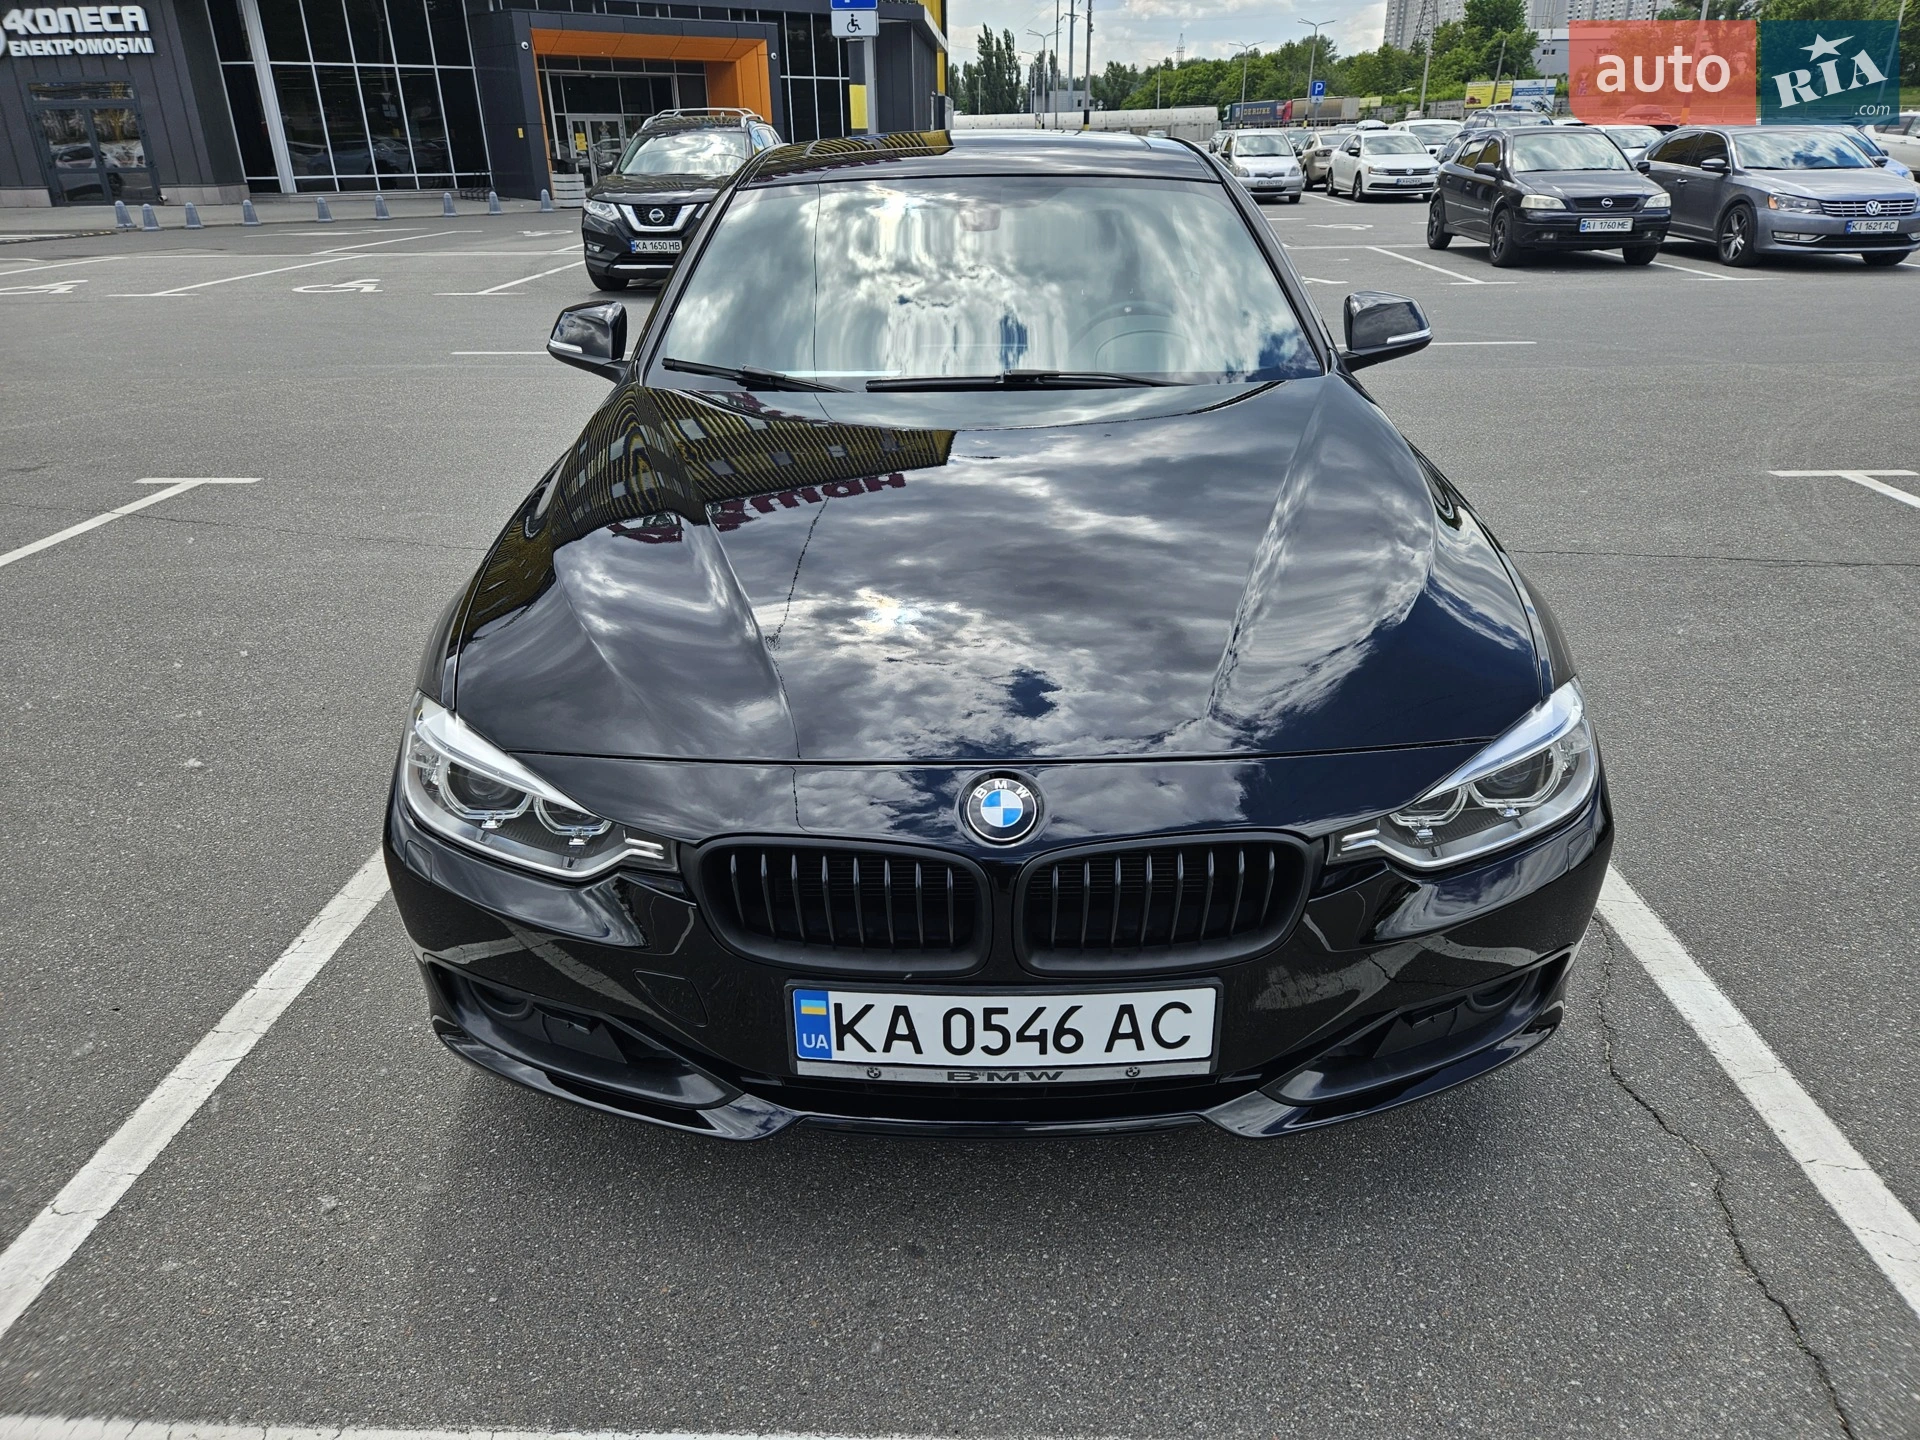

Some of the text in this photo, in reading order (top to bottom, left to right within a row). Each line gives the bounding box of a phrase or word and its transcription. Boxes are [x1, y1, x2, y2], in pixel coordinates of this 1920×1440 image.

[7, 37, 155, 57] ЕЛЕКТРОМОБІЛІ
[1315, 82, 1324, 95] P
[1600, 221, 1616, 230] 1760
[1865, 221, 1882, 231] 1621
[1883, 221, 1896, 230] AC
[635, 241, 681, 250] KA 1650 HB
[974, 780, 1031, 800] BMW
[833, 1001, 1193, 1057] KA 0546 AC
[803, 1033, 829, 1050] UA
[947, 1070, 1064, 1082] BMW
